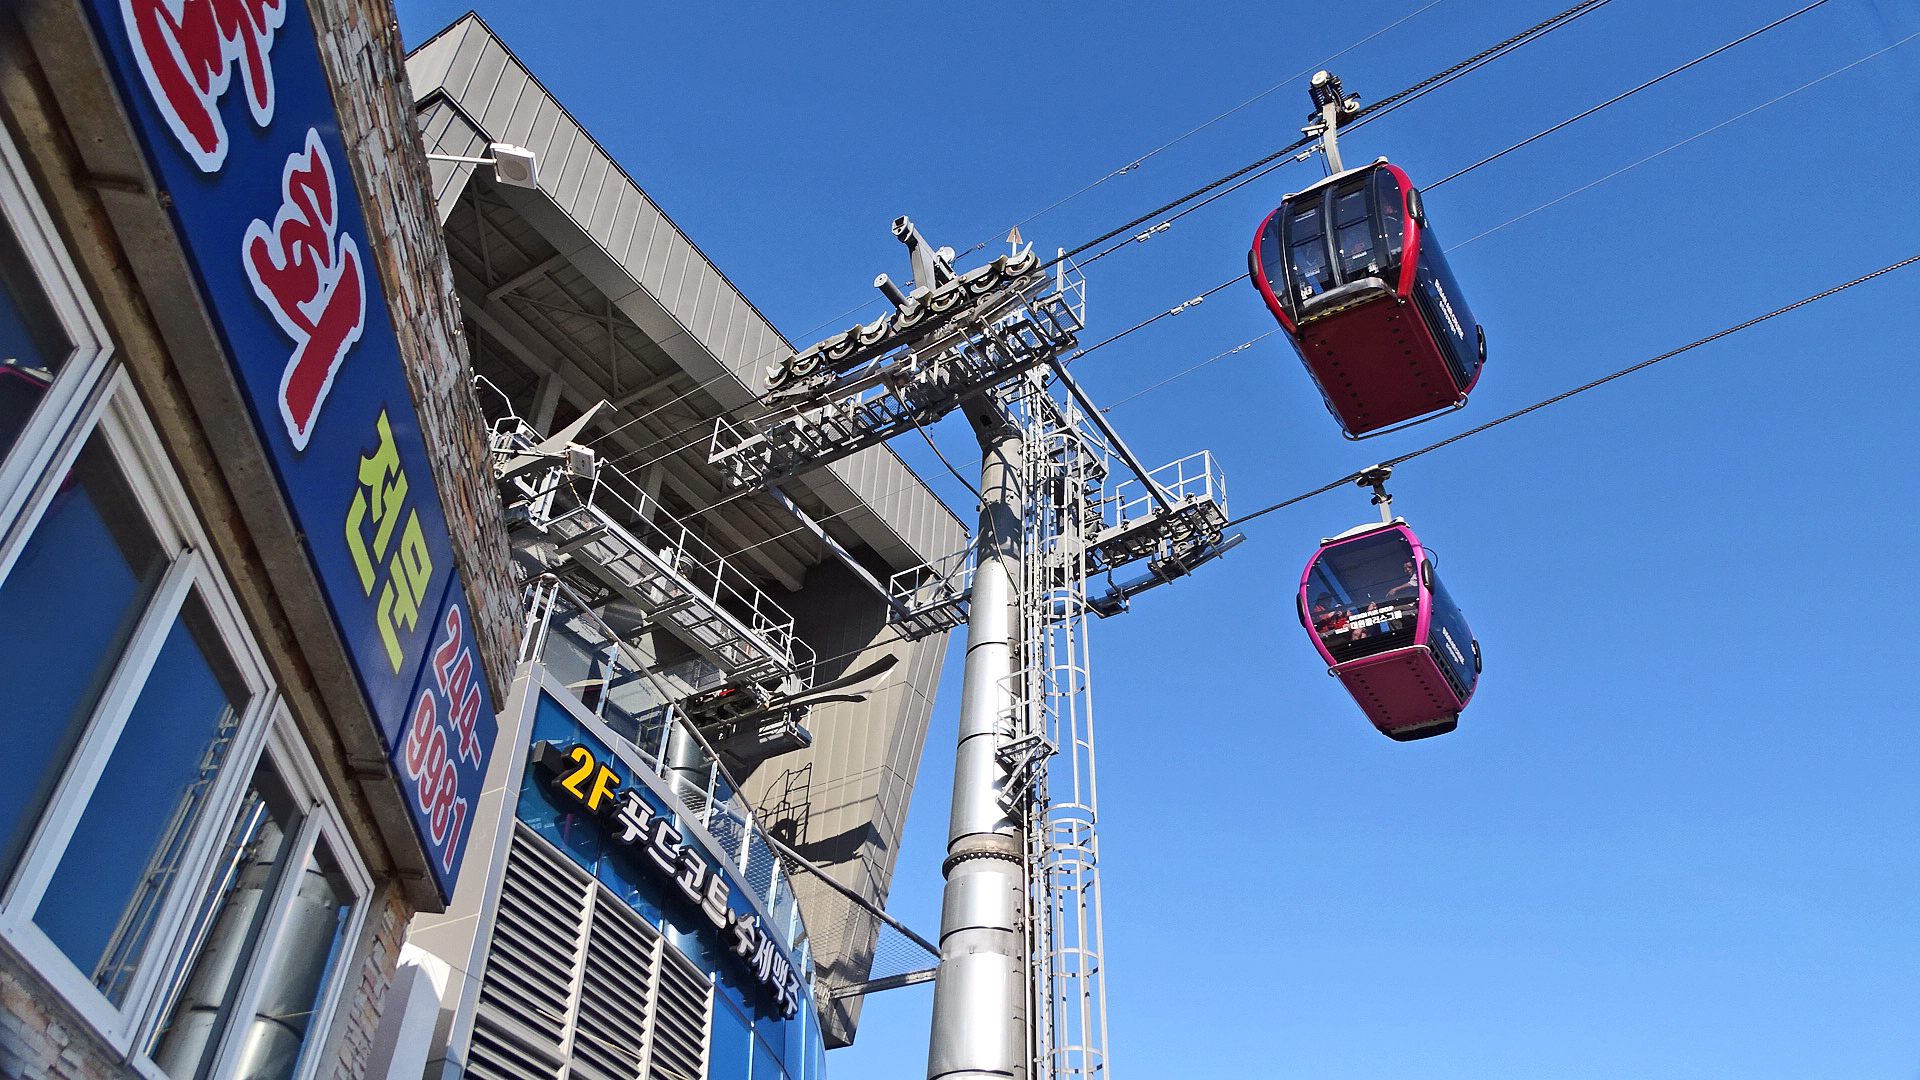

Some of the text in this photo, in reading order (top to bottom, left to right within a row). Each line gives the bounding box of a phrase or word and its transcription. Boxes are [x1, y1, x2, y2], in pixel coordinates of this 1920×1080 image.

[345, 409, 433, 675] 전문
[433, 603, 481, 771] 244-
[405, 688, 468, 875] 9981
[560, 746, 621, 812] 2F
